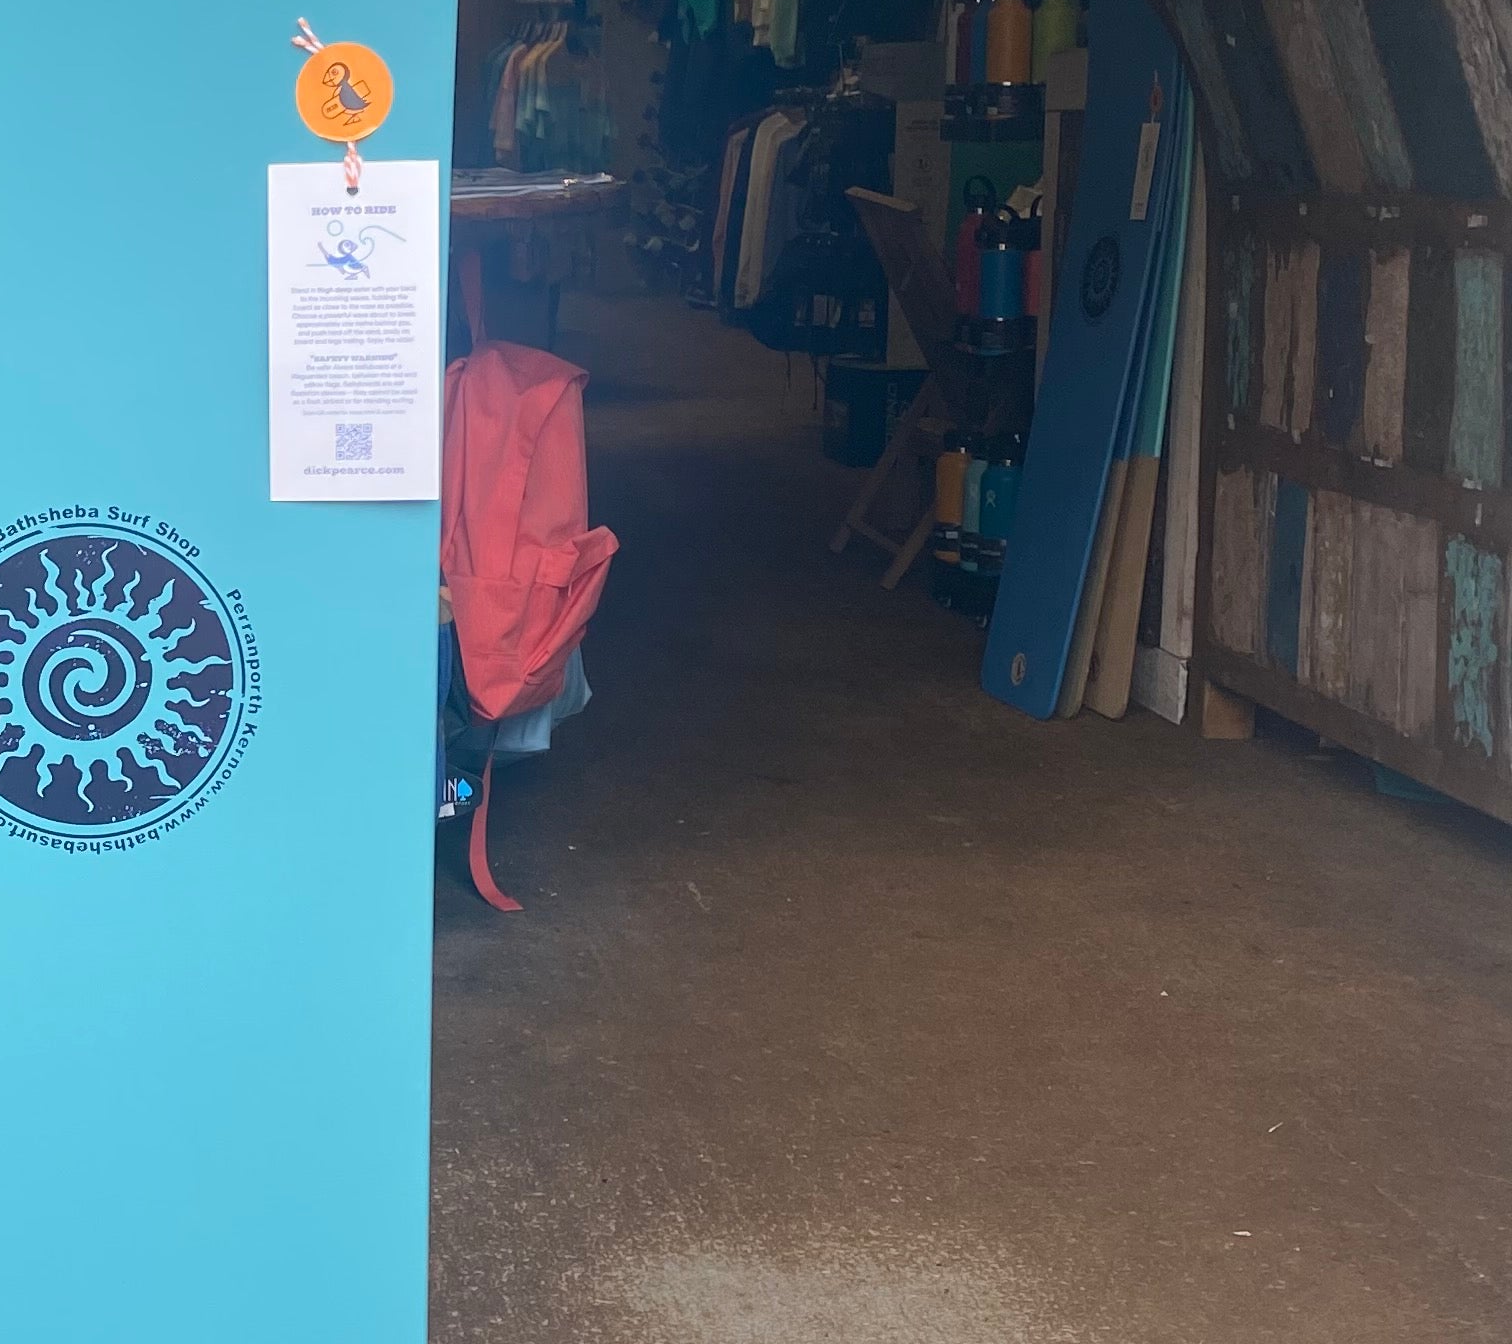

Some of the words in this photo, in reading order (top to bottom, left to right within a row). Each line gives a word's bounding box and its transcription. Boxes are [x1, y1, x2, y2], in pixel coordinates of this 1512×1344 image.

[311, 206, 342, 216] HOW
[345, 206, 362, 215] TO
[364, 205, 397, 215] RIDE
[303, 465, 405, 477] dickpearce.com
[107, 506, 151, 529] Surf
[155, 522, 201, 559] Shop
[226, 589, 263, 714] Perranporth
